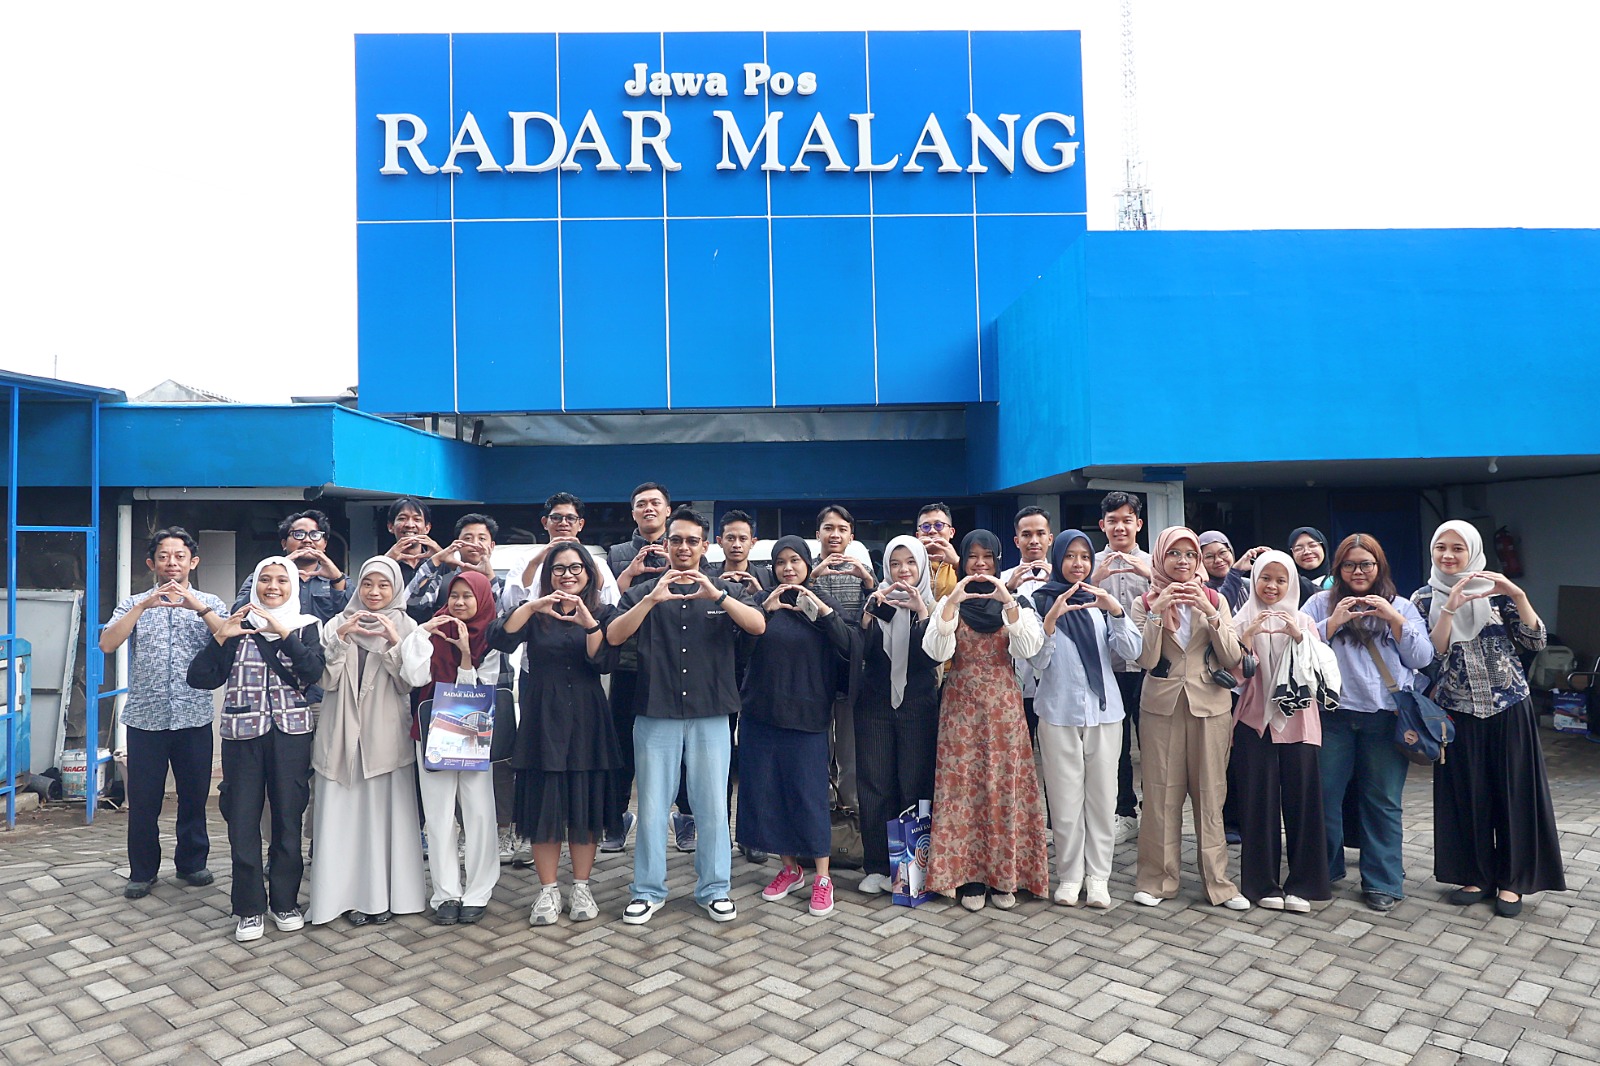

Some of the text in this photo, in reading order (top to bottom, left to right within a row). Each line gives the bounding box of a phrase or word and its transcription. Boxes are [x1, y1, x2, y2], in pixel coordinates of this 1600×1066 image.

[624, 62, 817, 97] Jawa Pos
[376, 109, 1080, 175] RADAR MALANG
